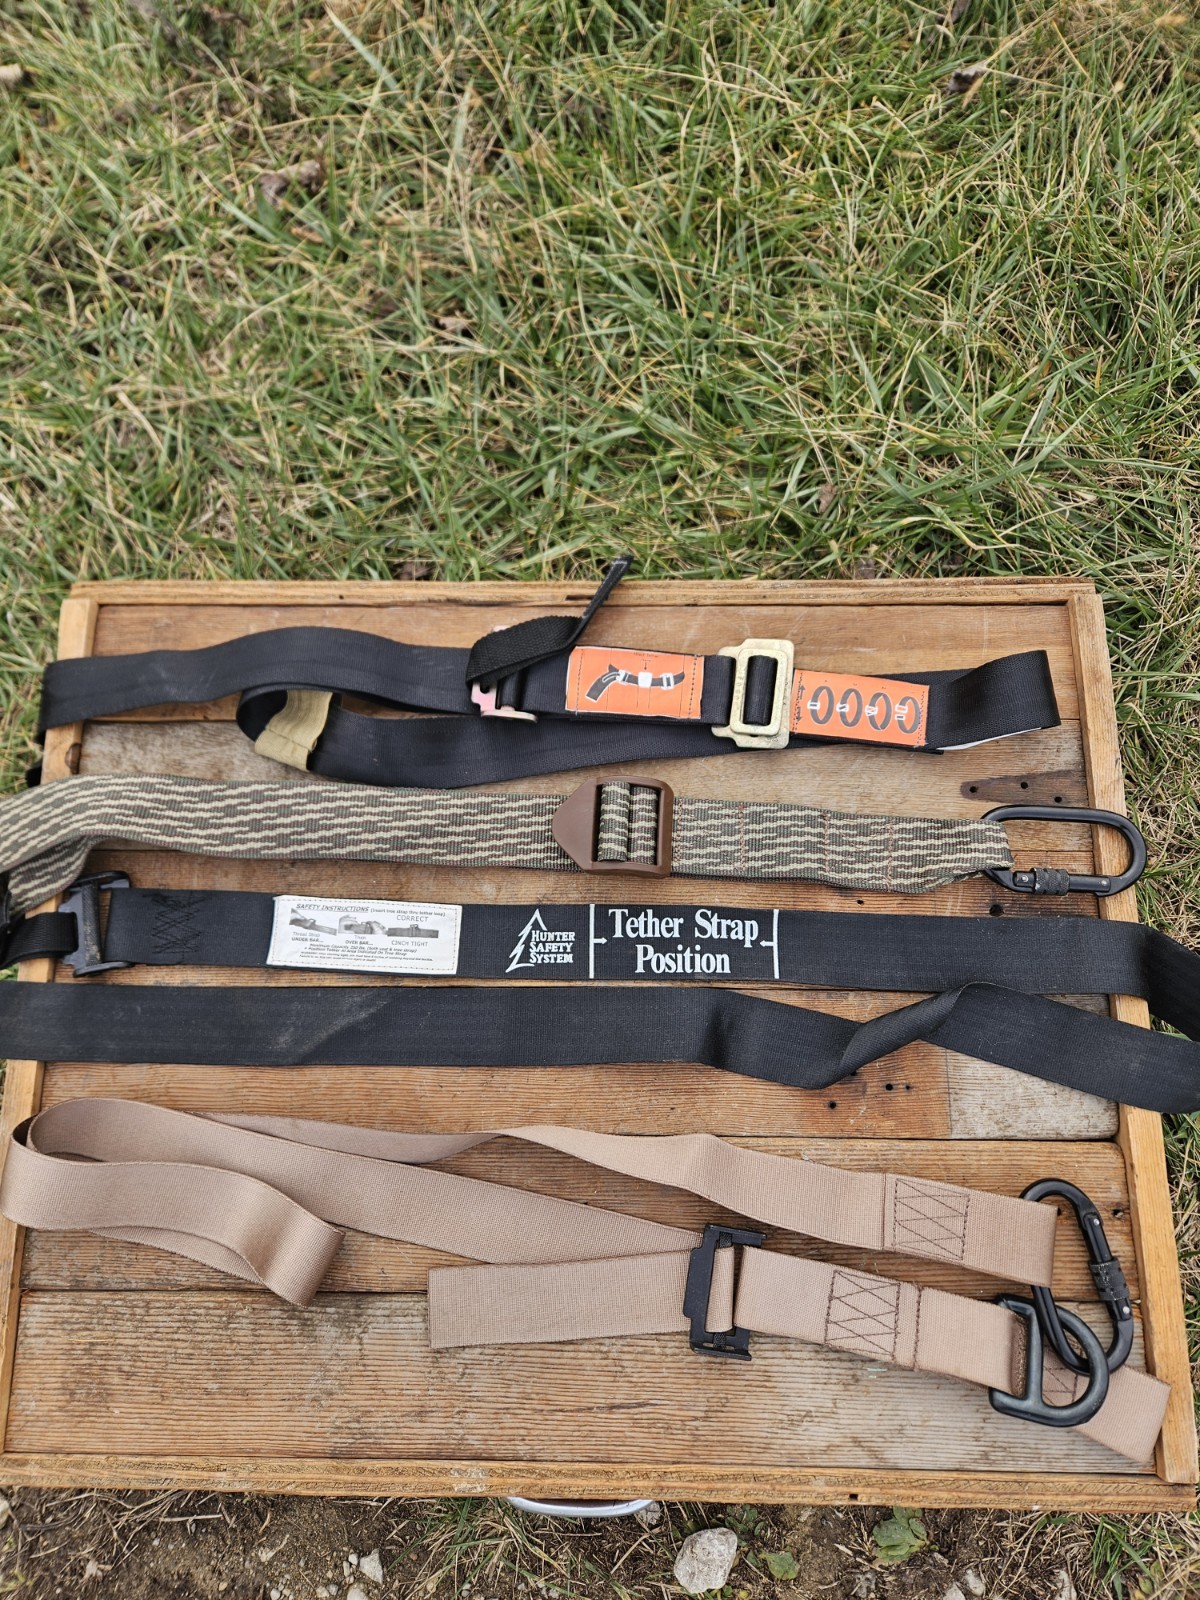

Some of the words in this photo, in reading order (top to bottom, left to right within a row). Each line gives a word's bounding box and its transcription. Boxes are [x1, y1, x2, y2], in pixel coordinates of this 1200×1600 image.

[296, 903, 320, 911] SAFETY
[321, 904, 370, 913] INSTRUCTIONS
[396, 914, 429, 922] CORRECT
[608, 908, 684, 938] Tether
[694, 908, 759, 948] Strap
[531, 930, 576, 941] HUNTER
[529, 942, 574, 952] SAFETY
[529, 952, 574, 963] SYSTEM
[634, 944, 731, 974] Position
